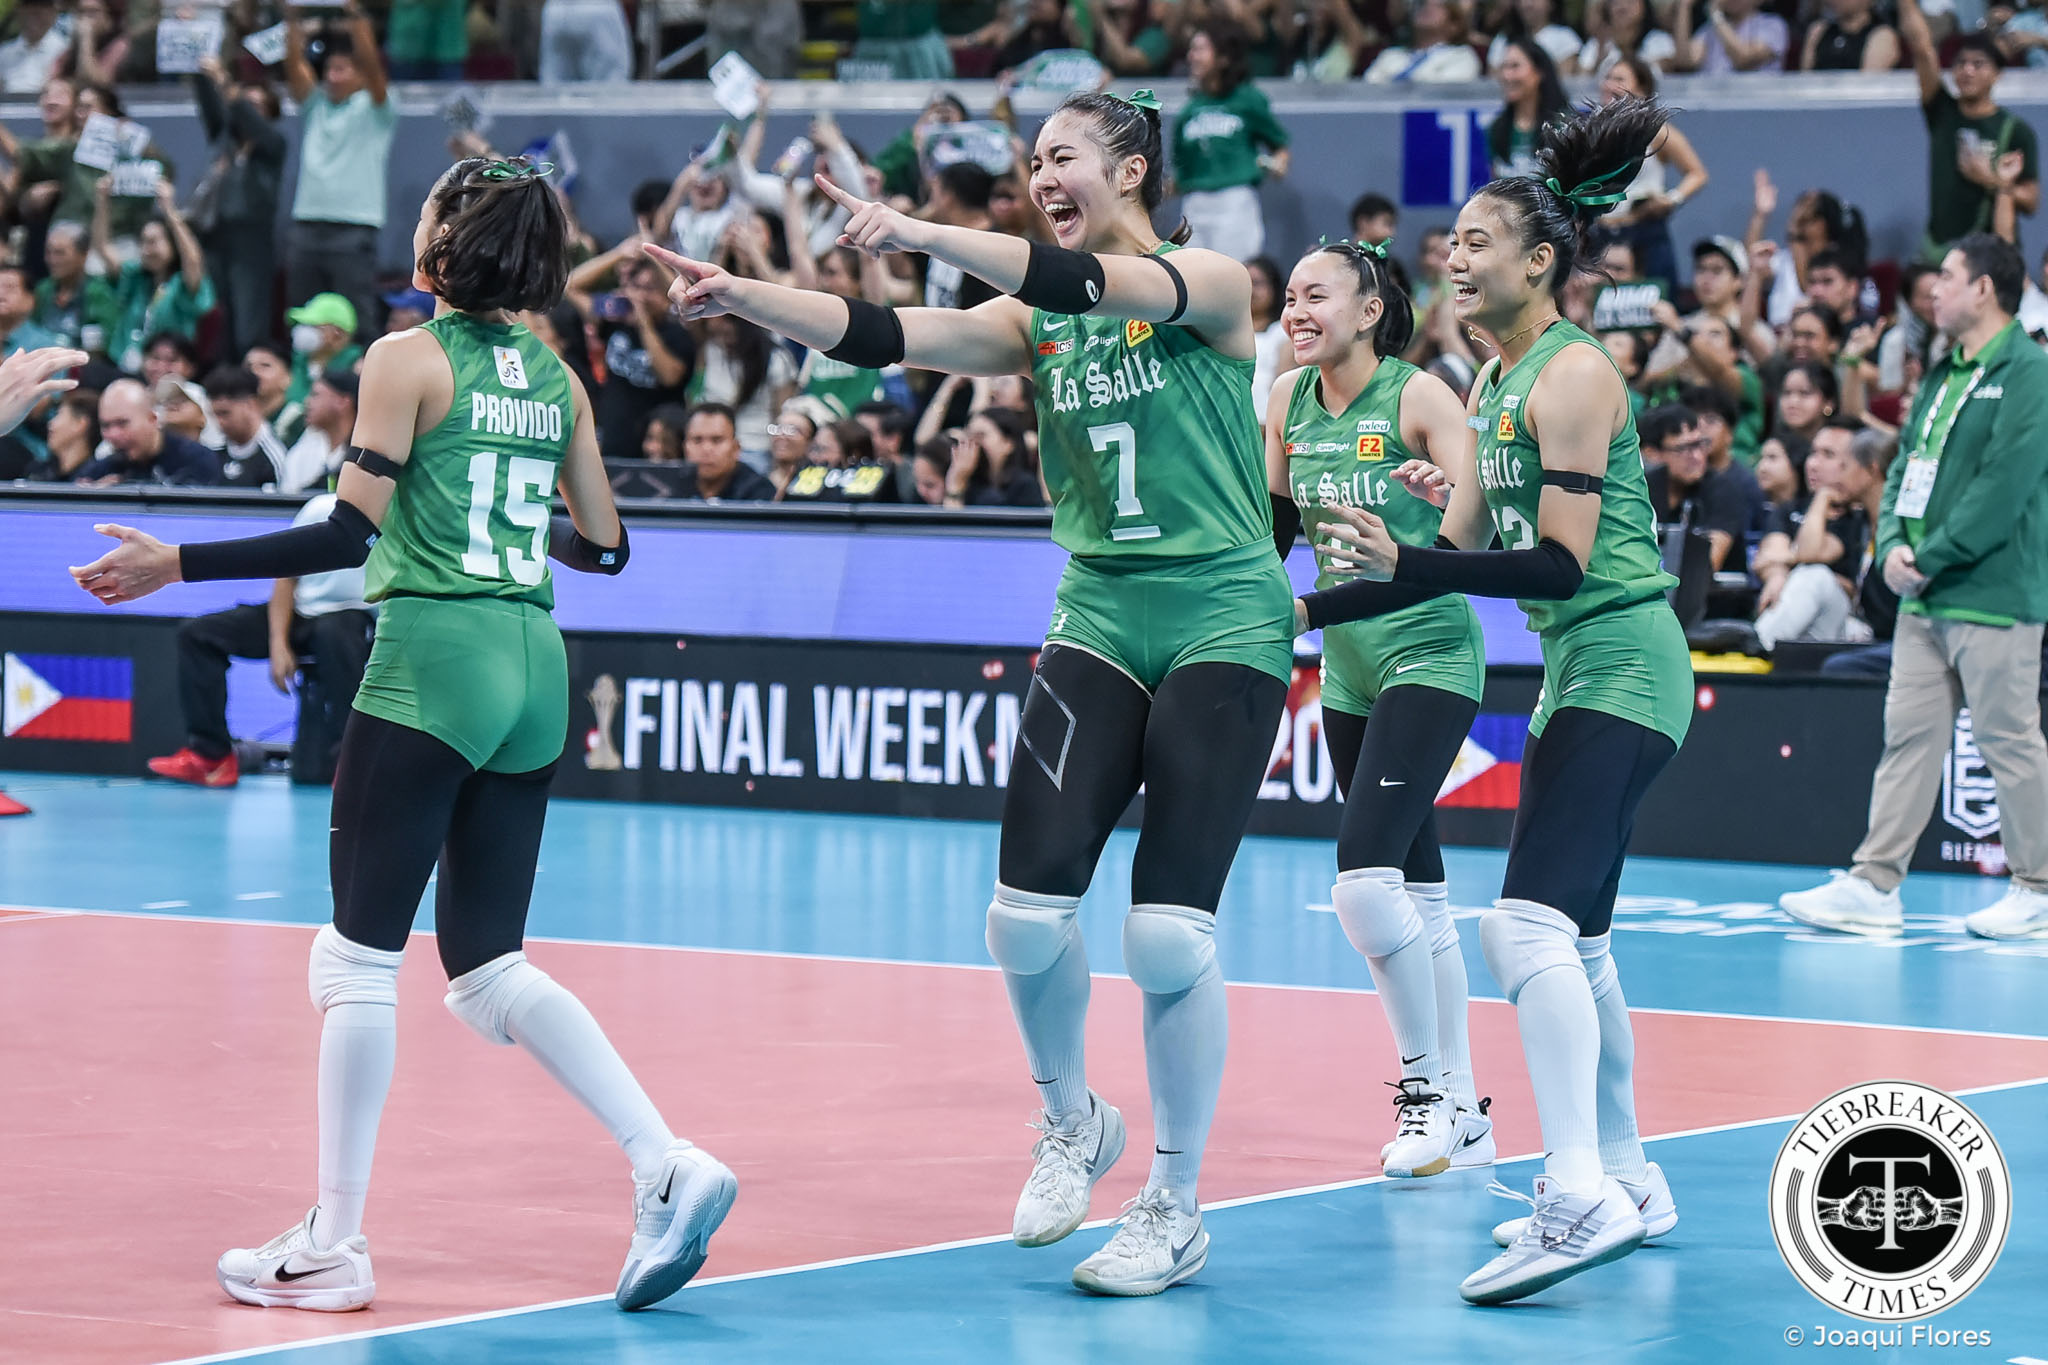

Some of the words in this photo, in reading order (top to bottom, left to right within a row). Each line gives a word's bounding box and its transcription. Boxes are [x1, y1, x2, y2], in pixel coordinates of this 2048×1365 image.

[1437, 112, 1497, 203] 1
[1100, 335, 1119, 346] light
[1051, 366, 1081, 413] La
[1084, 351, 1167, 409] Salle
[471, 392, 562, 442] PROVIDO
[1358, 421, 1389, 431] nxled
[1360, 438, 1380, 453] F2
[1087, 421, 1144, 516] 7
[1317, 471, 1389, 508] Salle
[461, 452, 556, 587] 15
[624, 677, 804, 778] FINAL
[813, 684, 987, 787] WEEK
[1256, 701, 1344, 804] 20
